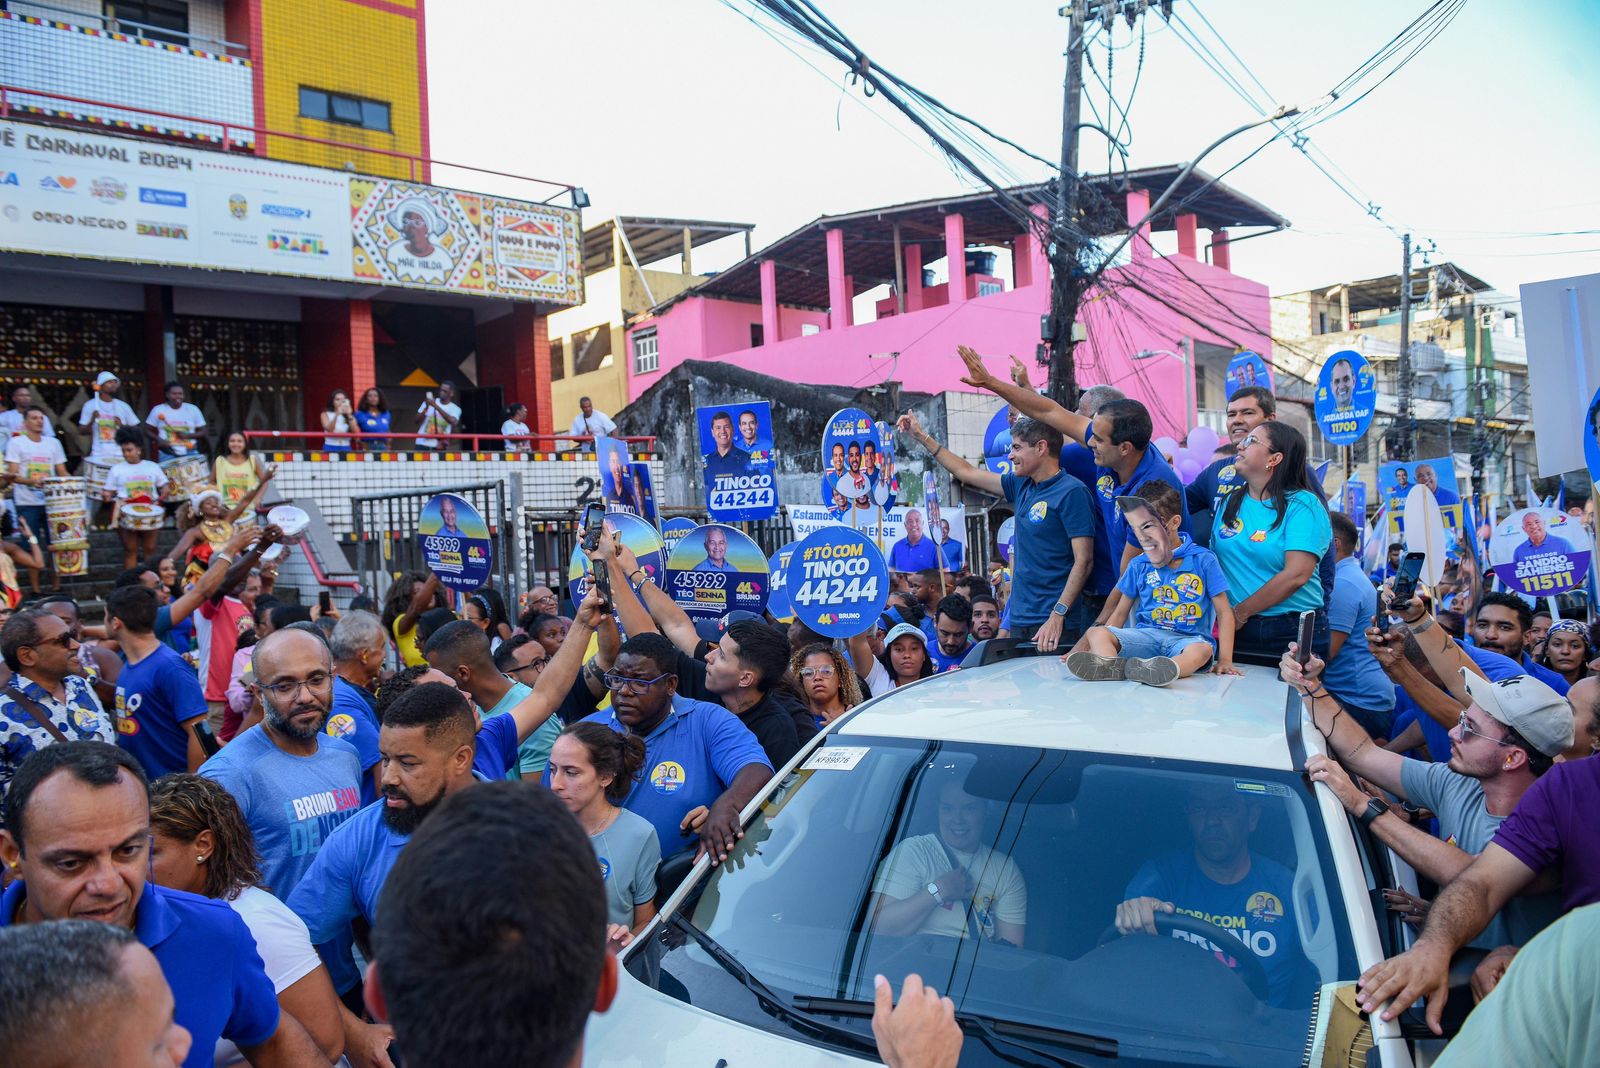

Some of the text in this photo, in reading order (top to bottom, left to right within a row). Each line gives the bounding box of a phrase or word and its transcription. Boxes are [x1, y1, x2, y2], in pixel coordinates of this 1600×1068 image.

[26, 134, 131, 163] CARNAVAL
[139, 151, 192, 171] 2024
[1332, 420, 1357, 434] 11700
[715, 474, 772, 490] TINOCO
[714, 490, 770, 506] 44244
[793, 509, 833, 521] Estamos
[425, 536, 460, 552] 45999
[833, 544, 864, 558] COM
[1516, 555, 1568, 570] SANDRO
[1524, 552, 1558, 560] VEREADOR
[802, 558, 870, 579] TINOCO
[1514, 562, 1574, 578] BAHIENSE
[674, 572, 726, 589] 45999
[1521, 572, 1574, 592] 11511
[676, 589, 725, 600] TÉO SENNA
[795, 576, 878, 606] 44244
